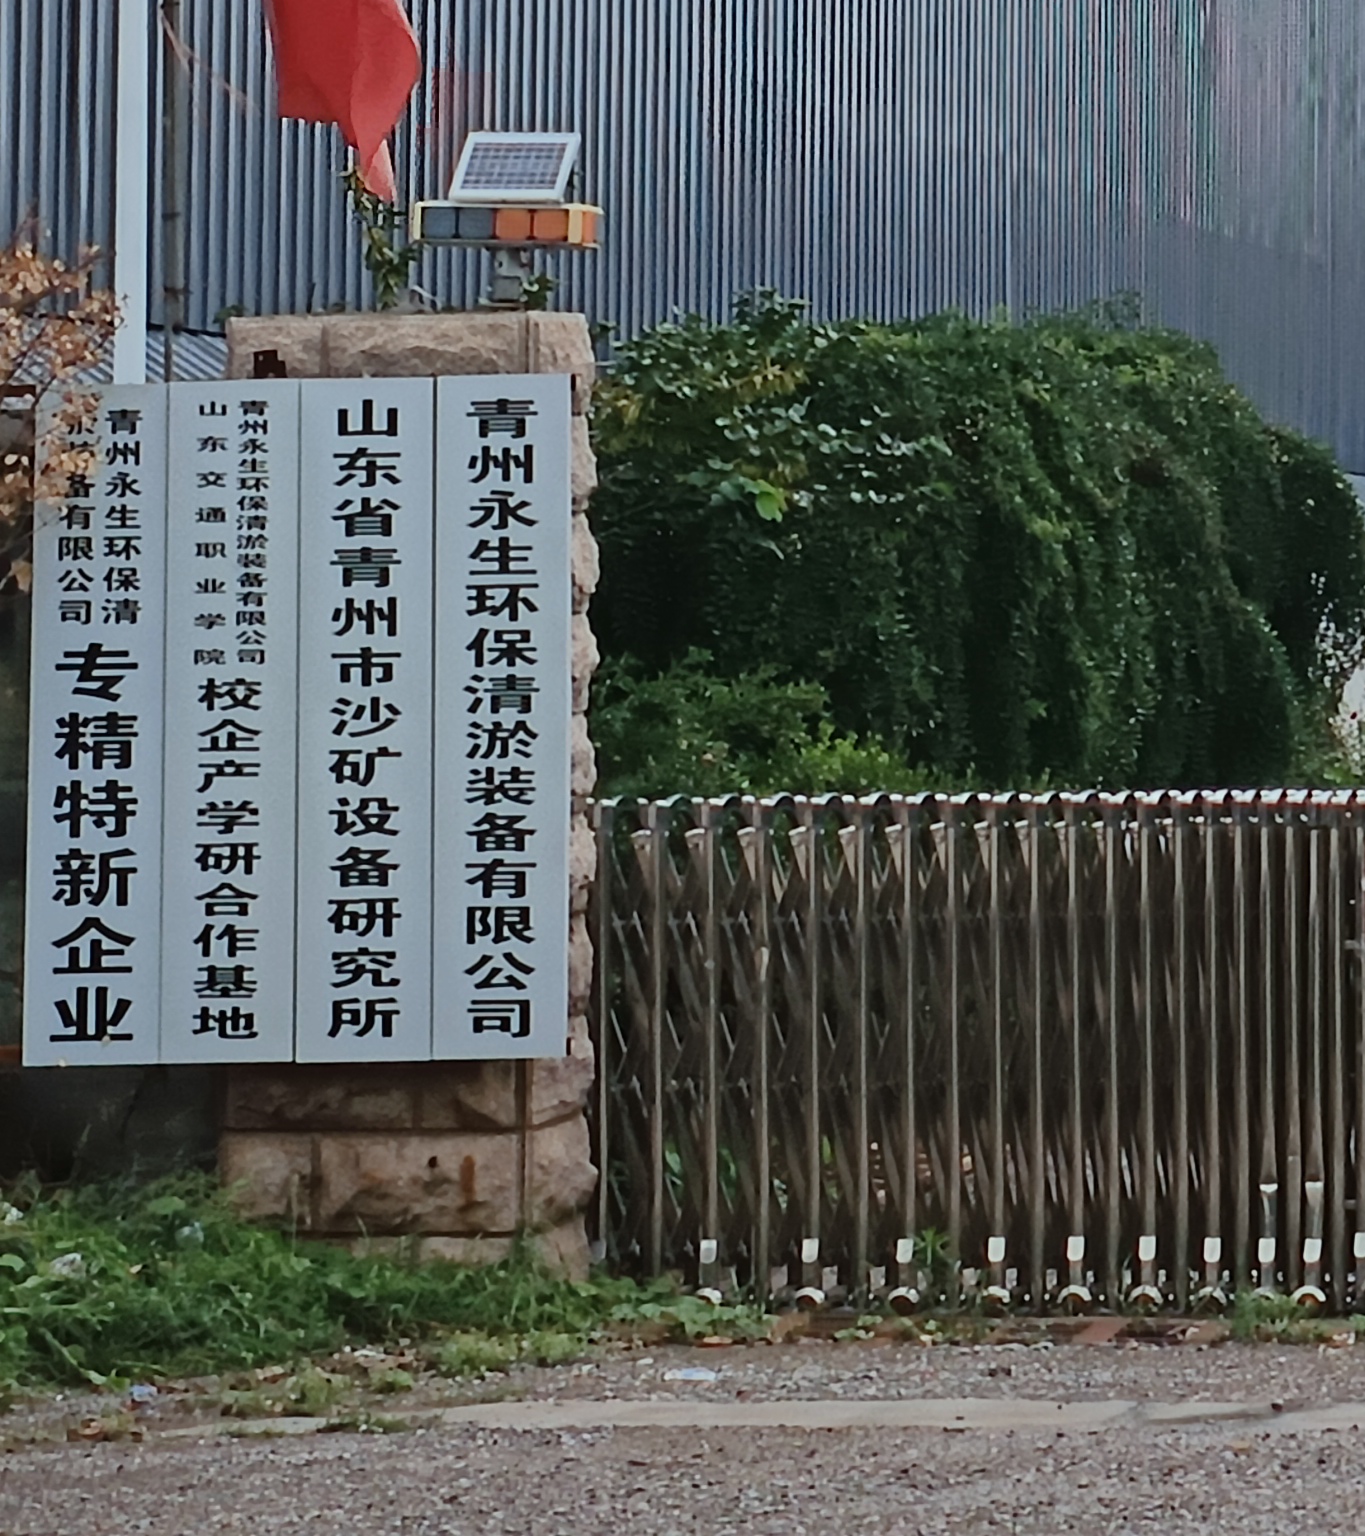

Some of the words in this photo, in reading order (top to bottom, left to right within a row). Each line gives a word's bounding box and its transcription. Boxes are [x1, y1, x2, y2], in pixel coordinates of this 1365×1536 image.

[101, 408, 143, 625] 青州永生环保清
[193, 400, 227, 665] 山东交通职业学院
[235, 400, 269, 665] 青州永生环保清淤装备有限公司
[49, 642, 139, 1043] 专精特新企业
[191, 677, 262, 1040] 校企产学研合作基地
[327, 398, 403, 1038] 山东省青州市沙矿设备研究所
[463, 398, 540, 1039] 青州永生环保清淤装备有限公司
